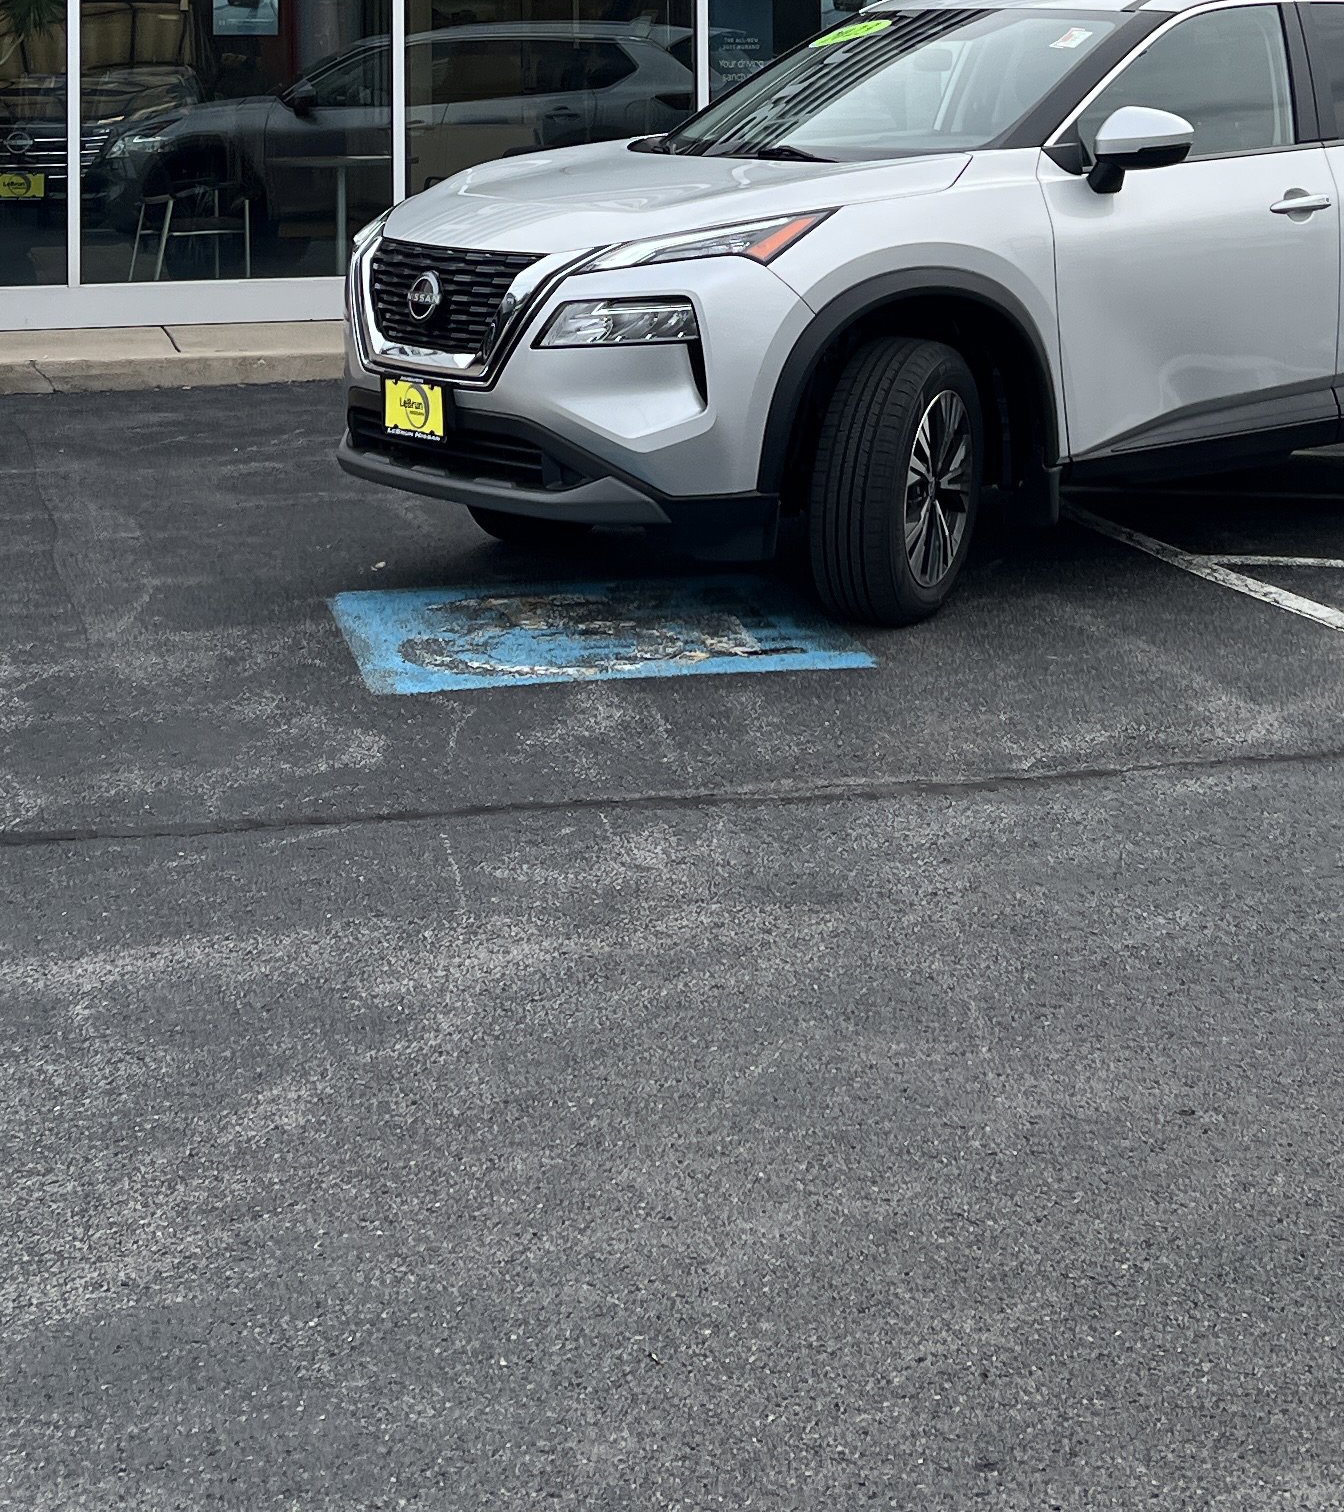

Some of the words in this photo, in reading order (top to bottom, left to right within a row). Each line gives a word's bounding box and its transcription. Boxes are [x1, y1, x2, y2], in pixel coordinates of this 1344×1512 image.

[718, 59, 736, 68] Your
[407, 292, 440, 305] NISSAN
[399, 397, 424, 410] LeBrun
